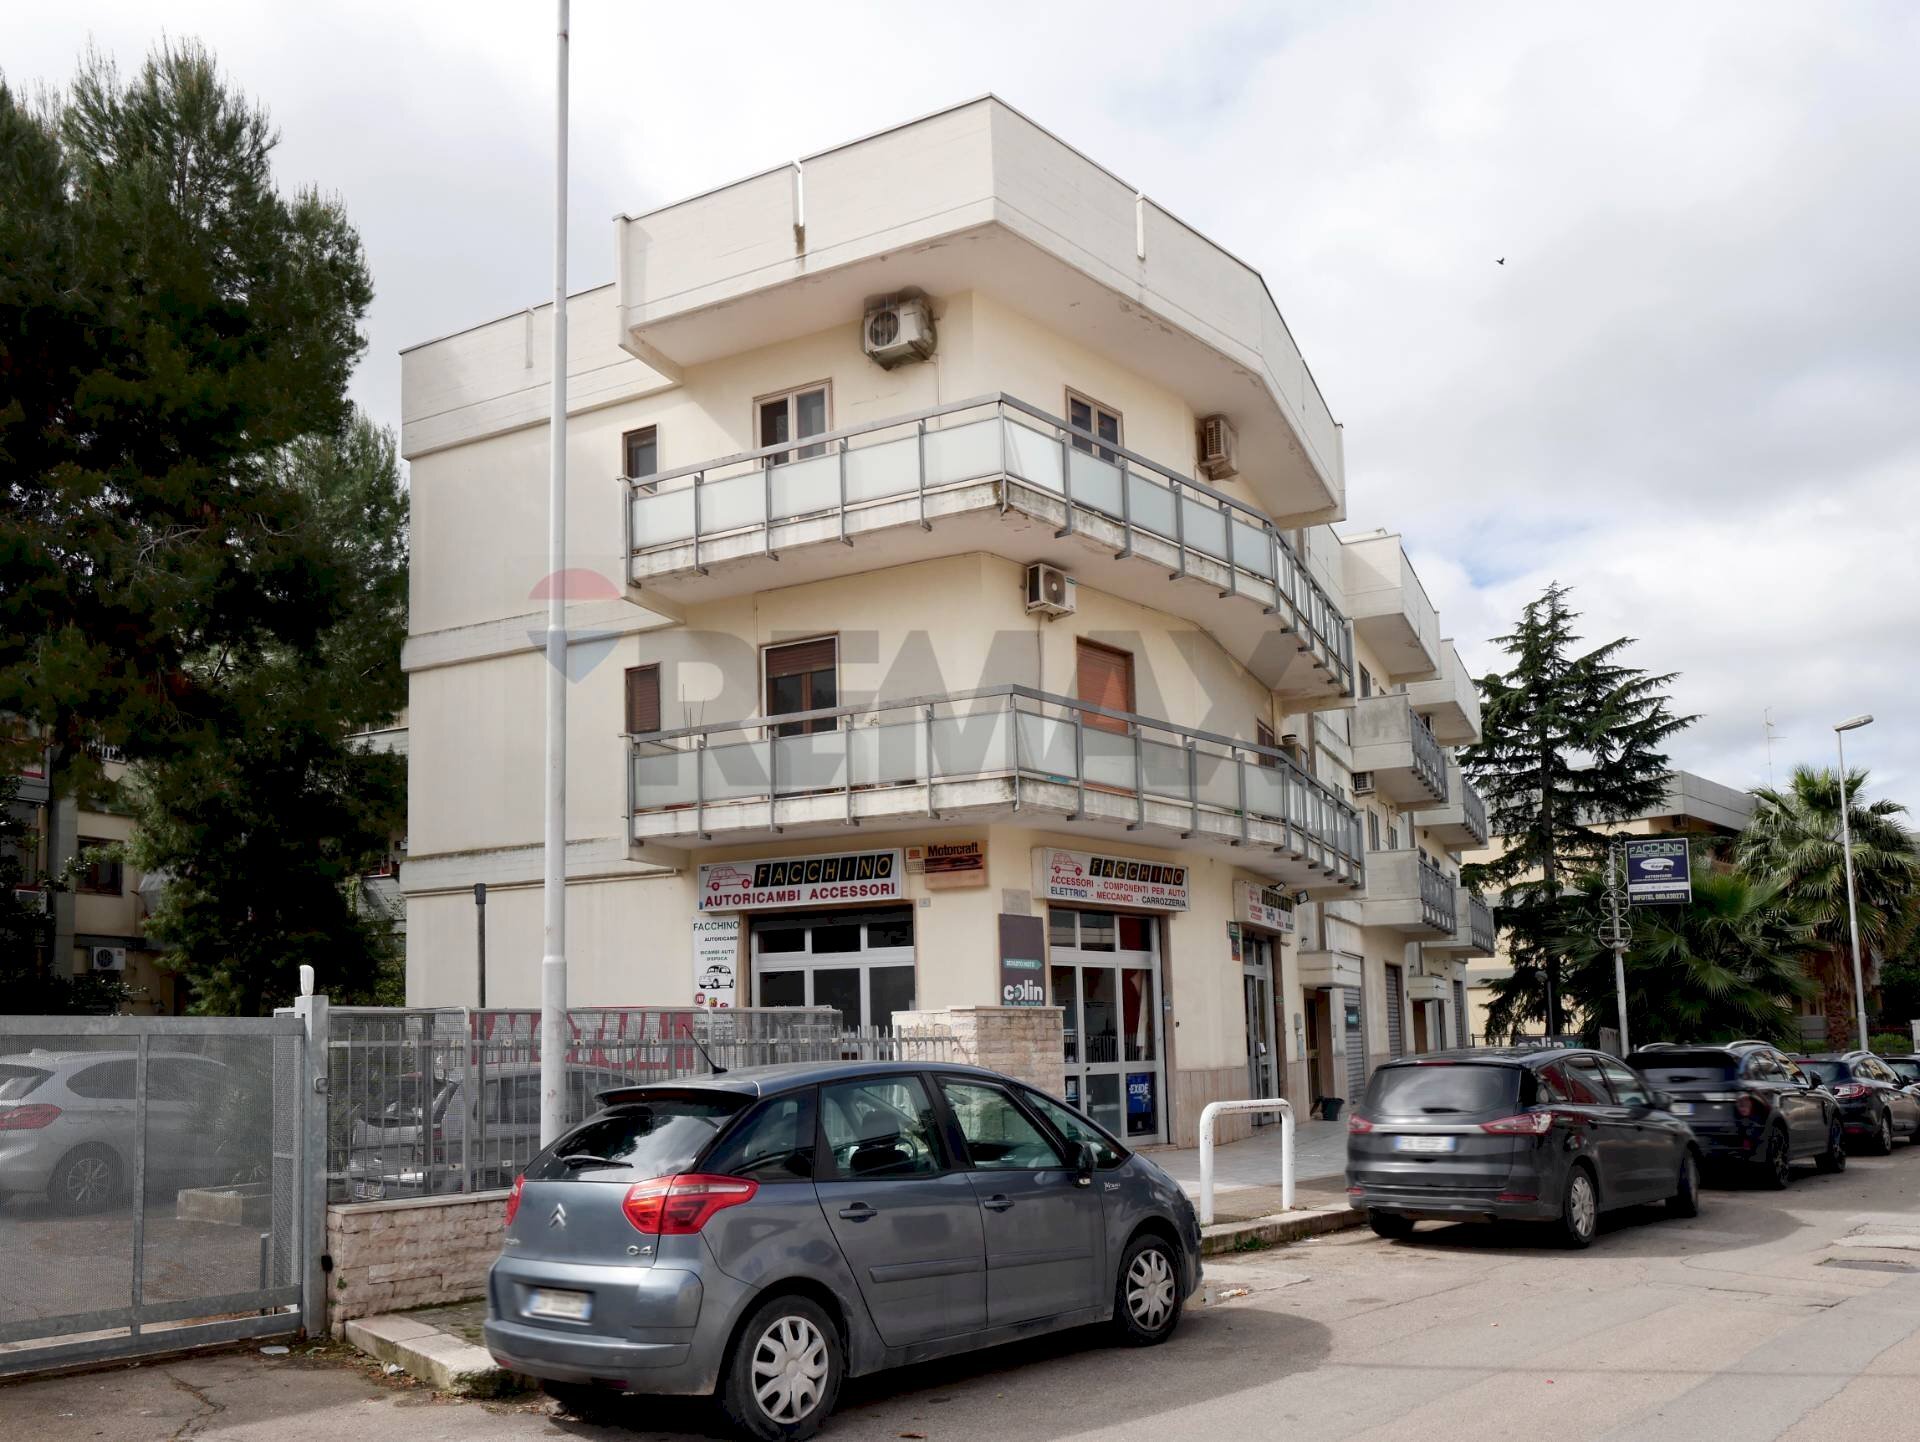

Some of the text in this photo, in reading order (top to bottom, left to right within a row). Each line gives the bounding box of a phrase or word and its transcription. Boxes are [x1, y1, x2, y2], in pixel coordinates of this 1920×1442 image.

[927, 842, 979, 857] Motorcraft
[755, 855, 892, 886] FACCHINO
[1090, 858, 1184, 885] FACCHINO
[704, 882, 896, 908] AUTORICAMBI ACCESSORI
[1051, 876, 1094, 888] ACCESSORI
[1103, 881, 1149, 894] COMPONENTI
[1151, 887, 1165, 896] PER
[1168, 888, 1186, 898] AUTO
[1051, 887, 1088, 898] ELETTRICI
[1096, 891, 1134, 903] MECCANICI
[1141, 896, 1186, 907] CARROZZERIA
[693, 920, 740, 932] FACCHINO
[1003, 979, 1044, 1001] colin
[1129, 1083, 1149, 1095] EXIDE
